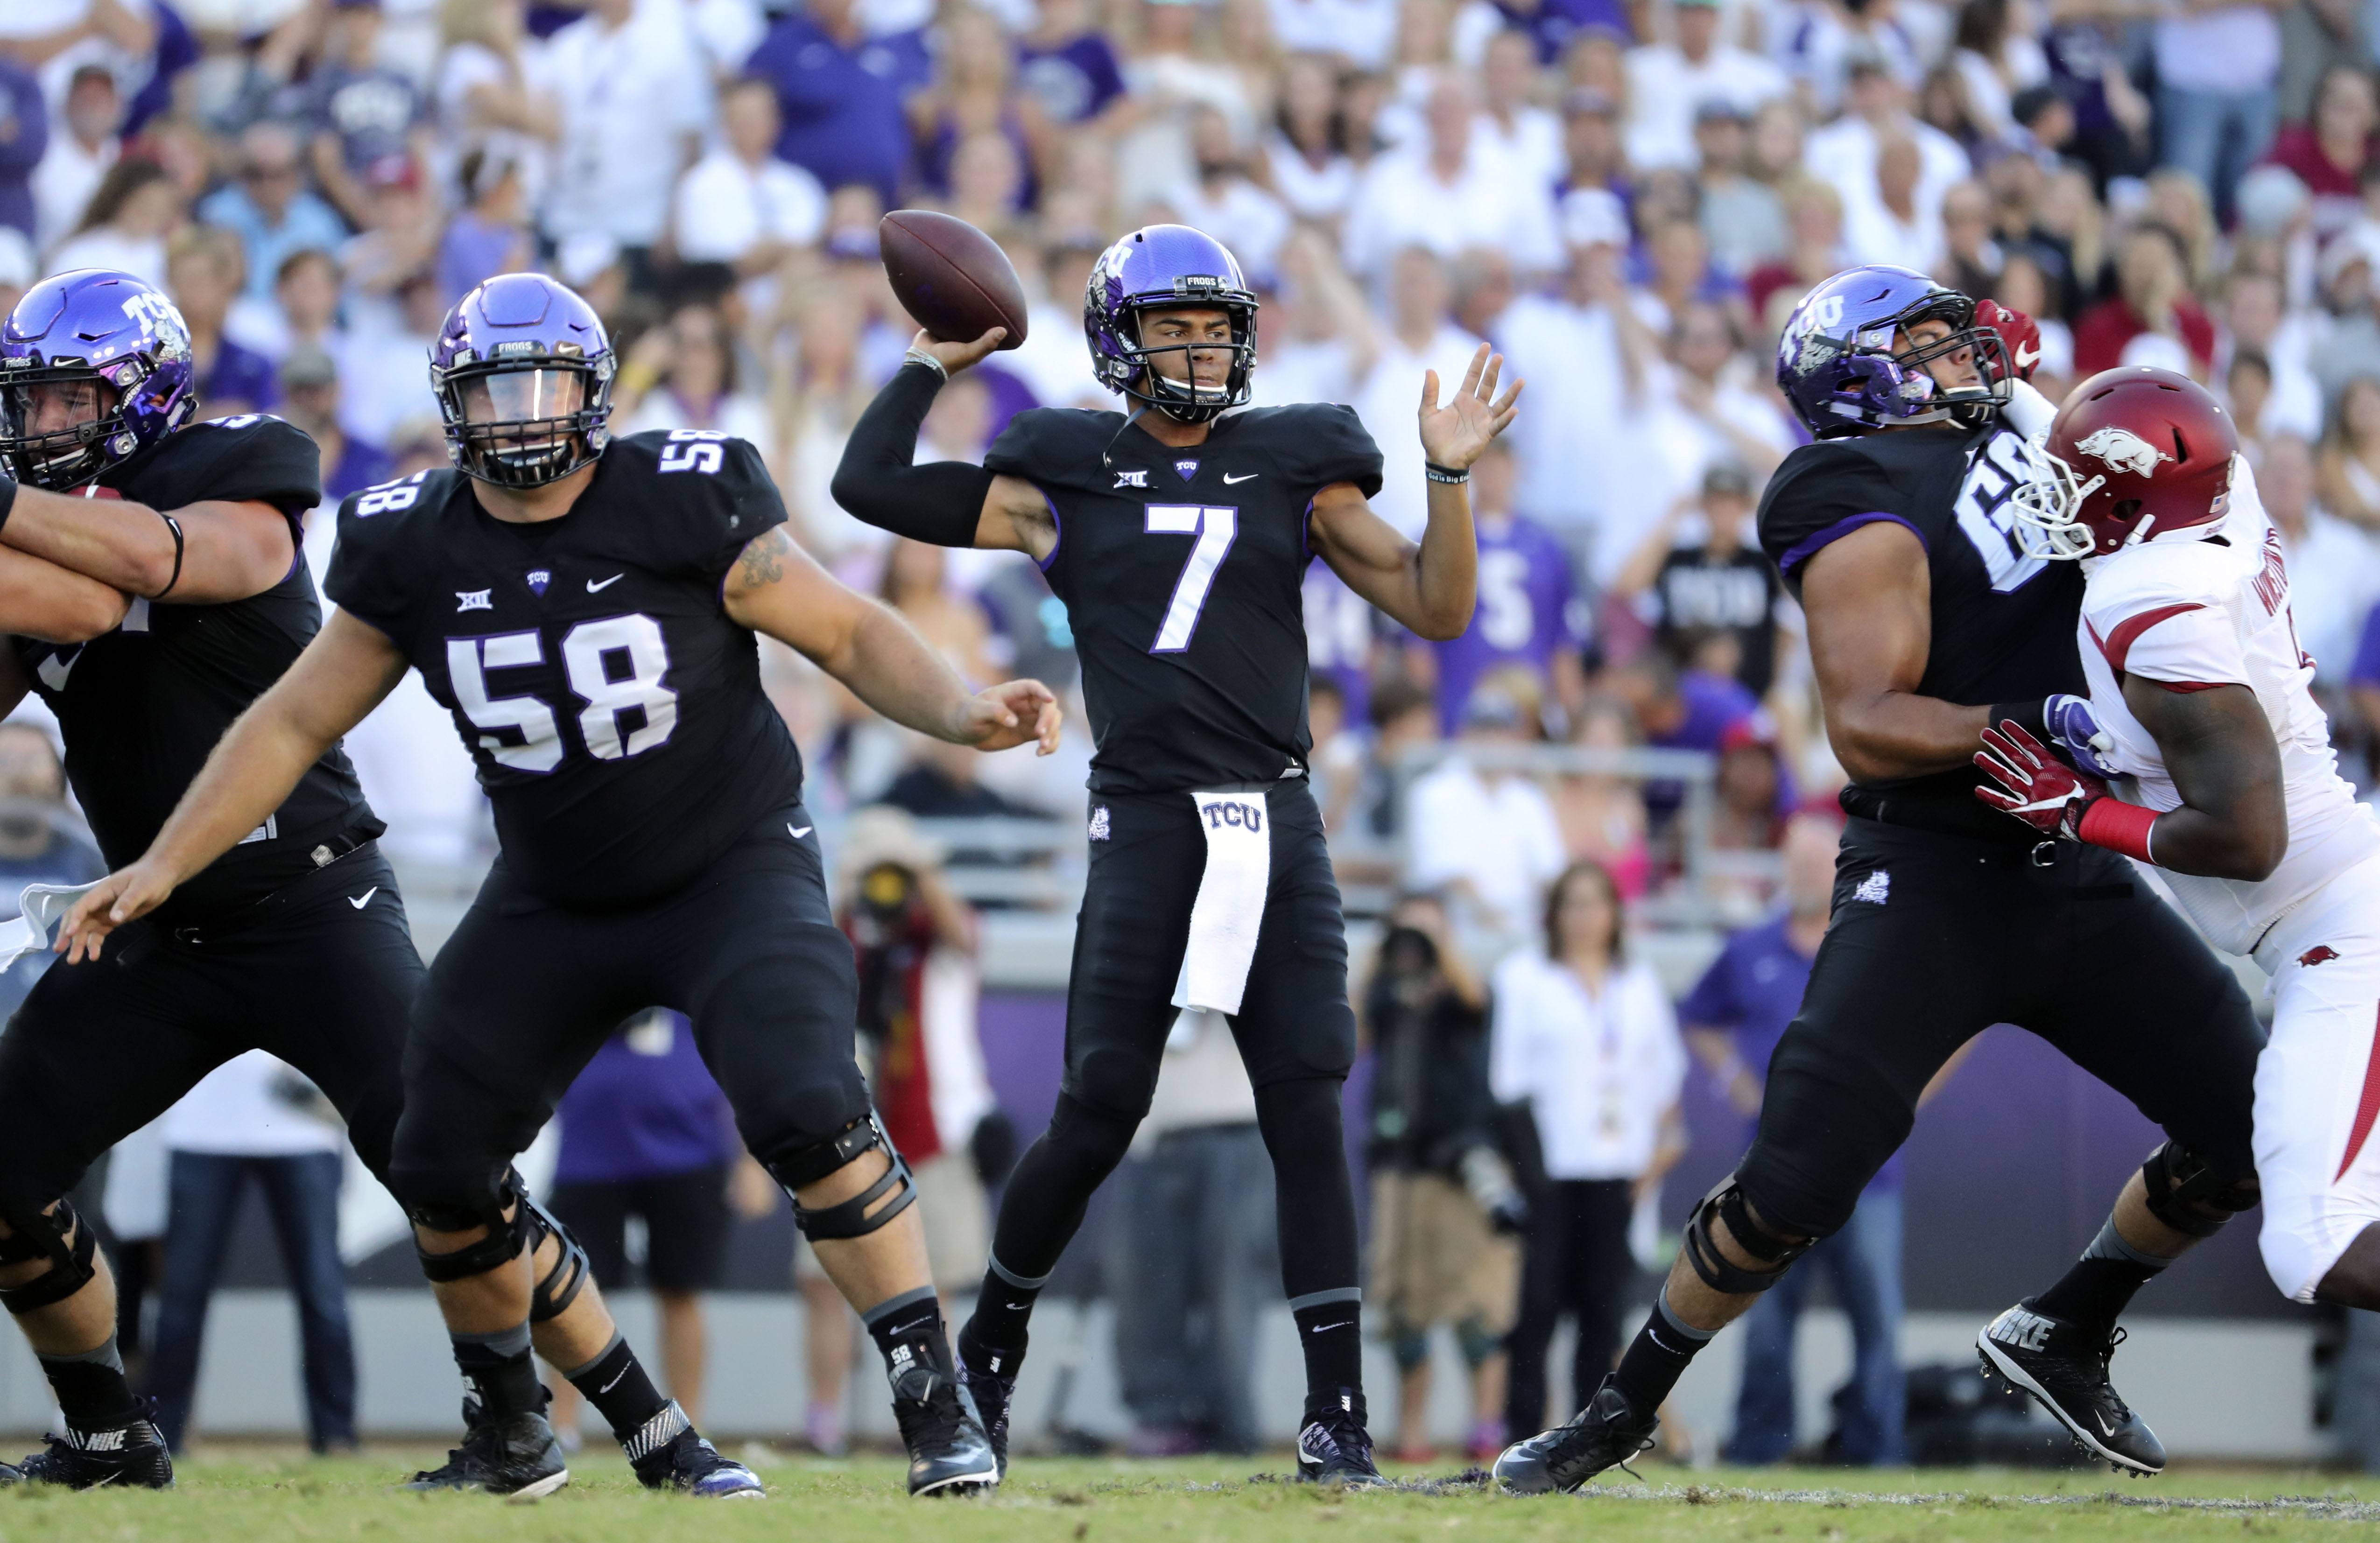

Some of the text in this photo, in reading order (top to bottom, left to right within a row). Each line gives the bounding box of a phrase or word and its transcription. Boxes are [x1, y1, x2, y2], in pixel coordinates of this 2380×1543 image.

[1187, 277, 1216, 286] FROGS
[498, 341, 532, 352] FROGS
[6, 357, 32, 368] FROGS
[657, 428, 730, 475] 58
[1176, 461, 1197, 470] TCU
[1113, 470, 1148, 489] XII
[527, 571, 550, 586] TCU
[1144, 503, 1238, 653] 7
[455, 588, 493, 613] XII
[1473, 547, 1536, 651] 5
[445, 612, 679, 776] 58
[1202, 801, 1261, 834] TCU
[1988, 1307, 2056, 1353] NIKE
[890, 1344, 912, 1365] 58
[85, 1429, 127, 1451] NIKE
